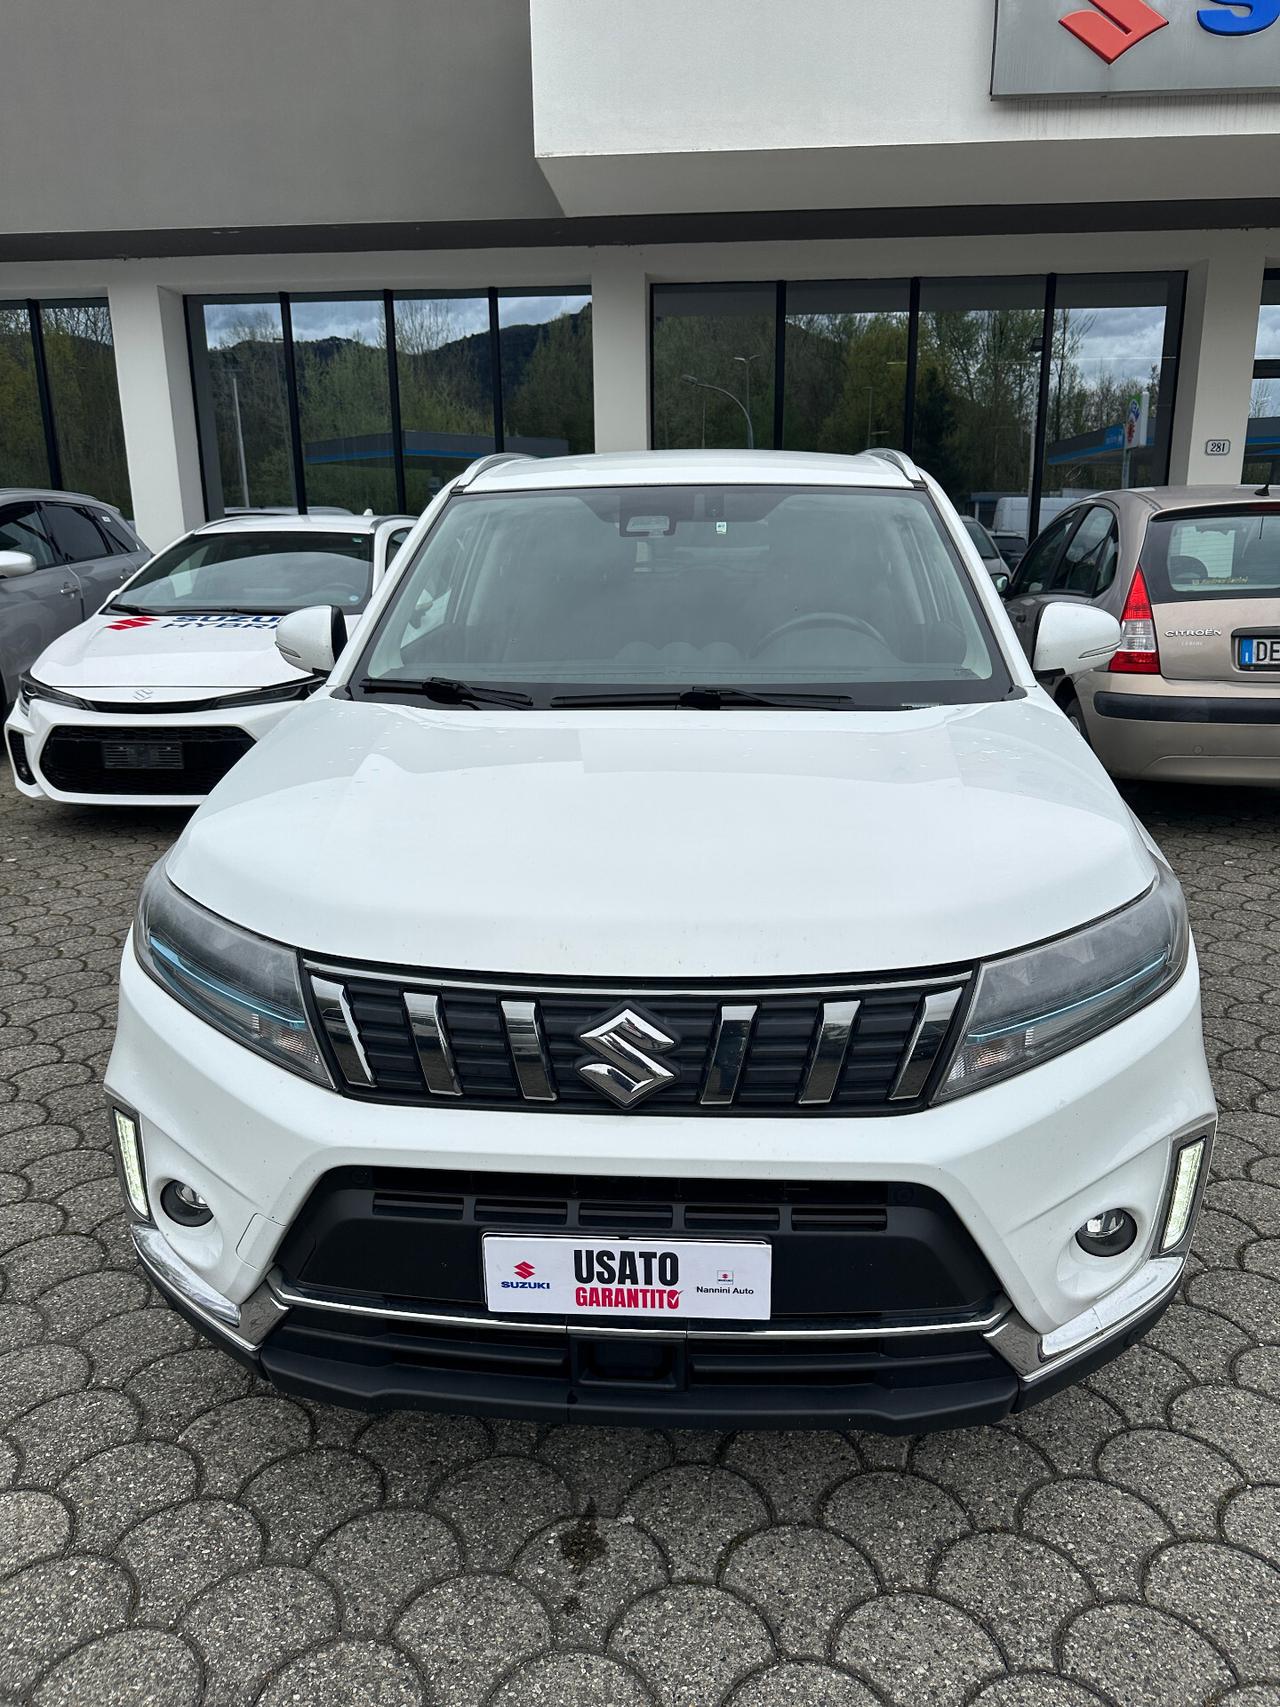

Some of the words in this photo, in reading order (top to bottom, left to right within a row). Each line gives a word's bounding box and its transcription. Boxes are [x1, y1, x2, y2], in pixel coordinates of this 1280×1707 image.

[1210, 442, 1226, 453] 281
[1164, 628, 1222, 637] CITROËN
[1256, 641, 1280, 661] DE
[573, 1249, 679, 1286] USATO
[501, 1281, 550, 1289] SUZUKI
[696, 1286, 731, 1294] Nannini
[732, 1287, 755, 1295] Auto
[575, 1286, 683, 1309] GARANTITO
